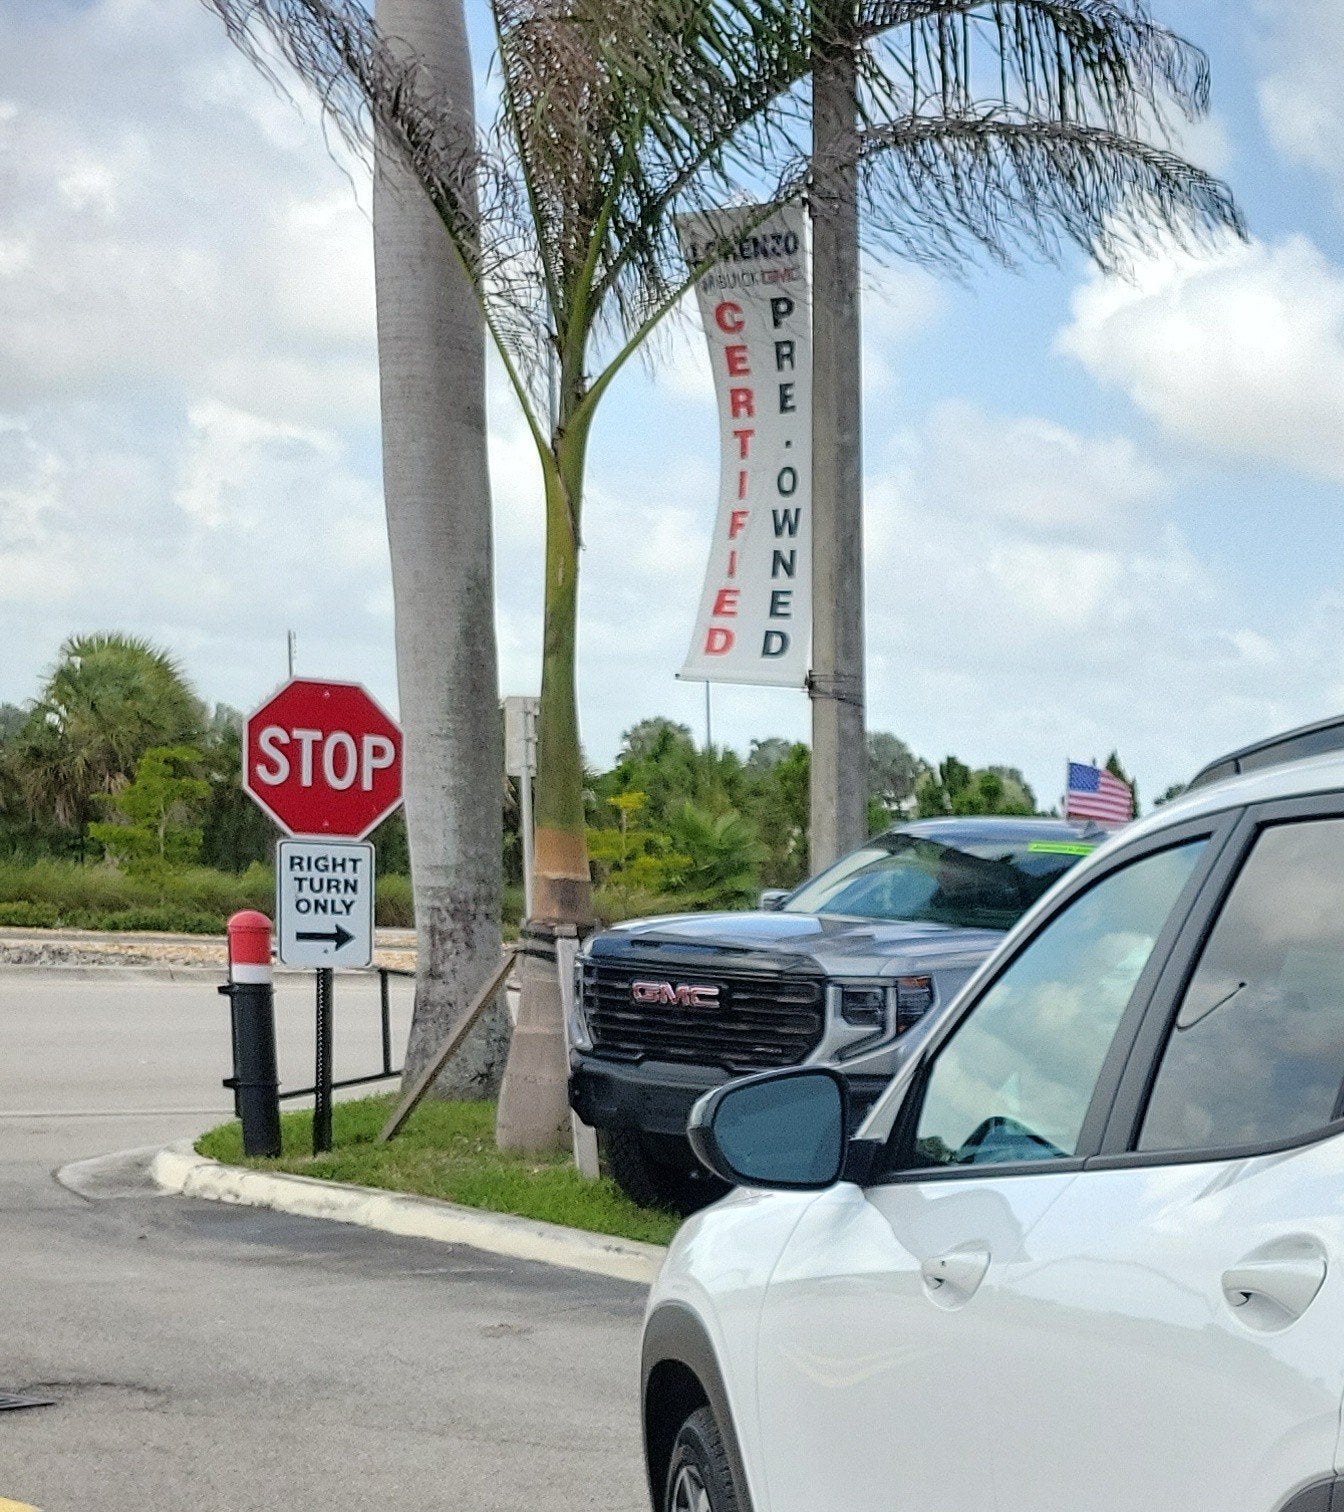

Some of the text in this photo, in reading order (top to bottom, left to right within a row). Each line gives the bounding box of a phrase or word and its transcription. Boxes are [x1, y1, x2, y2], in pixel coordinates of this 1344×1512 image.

[704, 301, 755, 656] CERTIFIED
[256, 725, 396, 792] STOP
[289, 854, 363, 874] RIGHT
[294, 877, 359, 895] TURN
[295, 898, 356, 916] ONLY
[631, 981, 720, 1009] GMC
